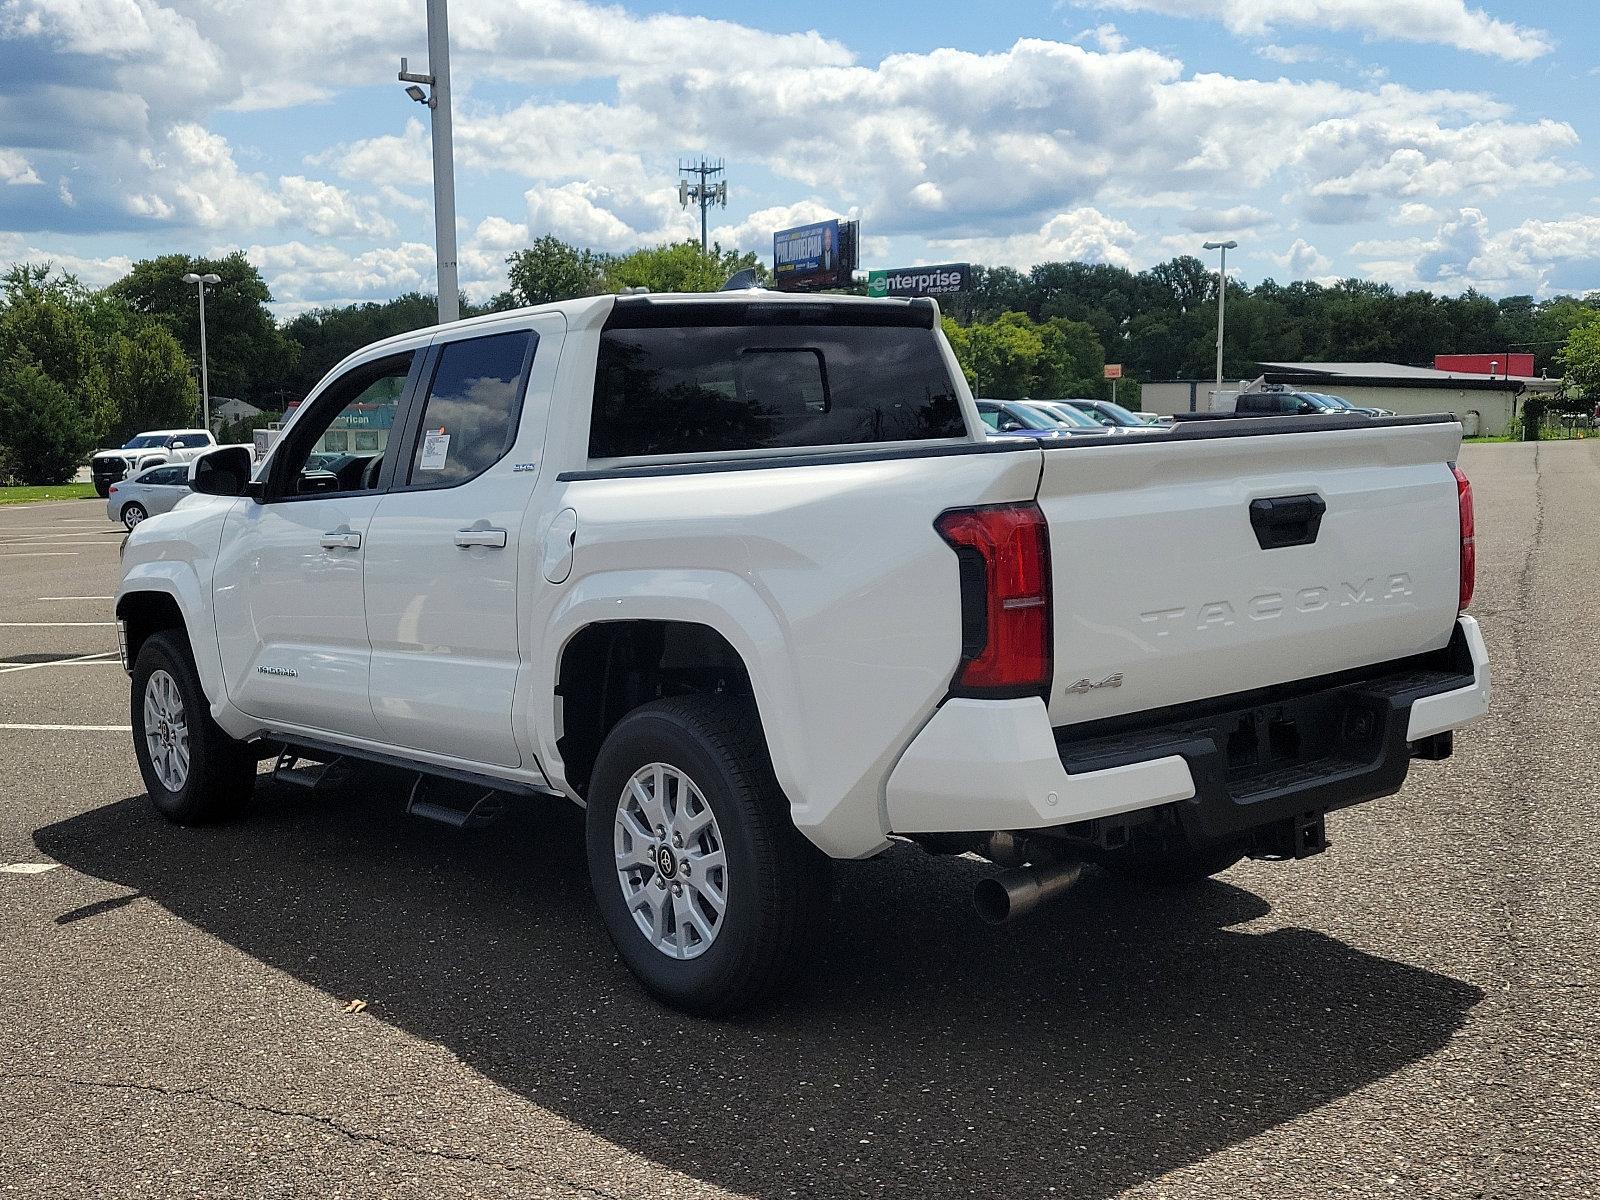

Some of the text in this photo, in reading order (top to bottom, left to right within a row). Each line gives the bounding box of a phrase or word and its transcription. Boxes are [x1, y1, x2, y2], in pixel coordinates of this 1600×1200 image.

[873, 269, 961, 292] enterprise
[927, 285, 961, 294] rent-a-car
[1140, 572, 1412, 637] TACOMA
[256, 664, 299, 678] TACOMA
